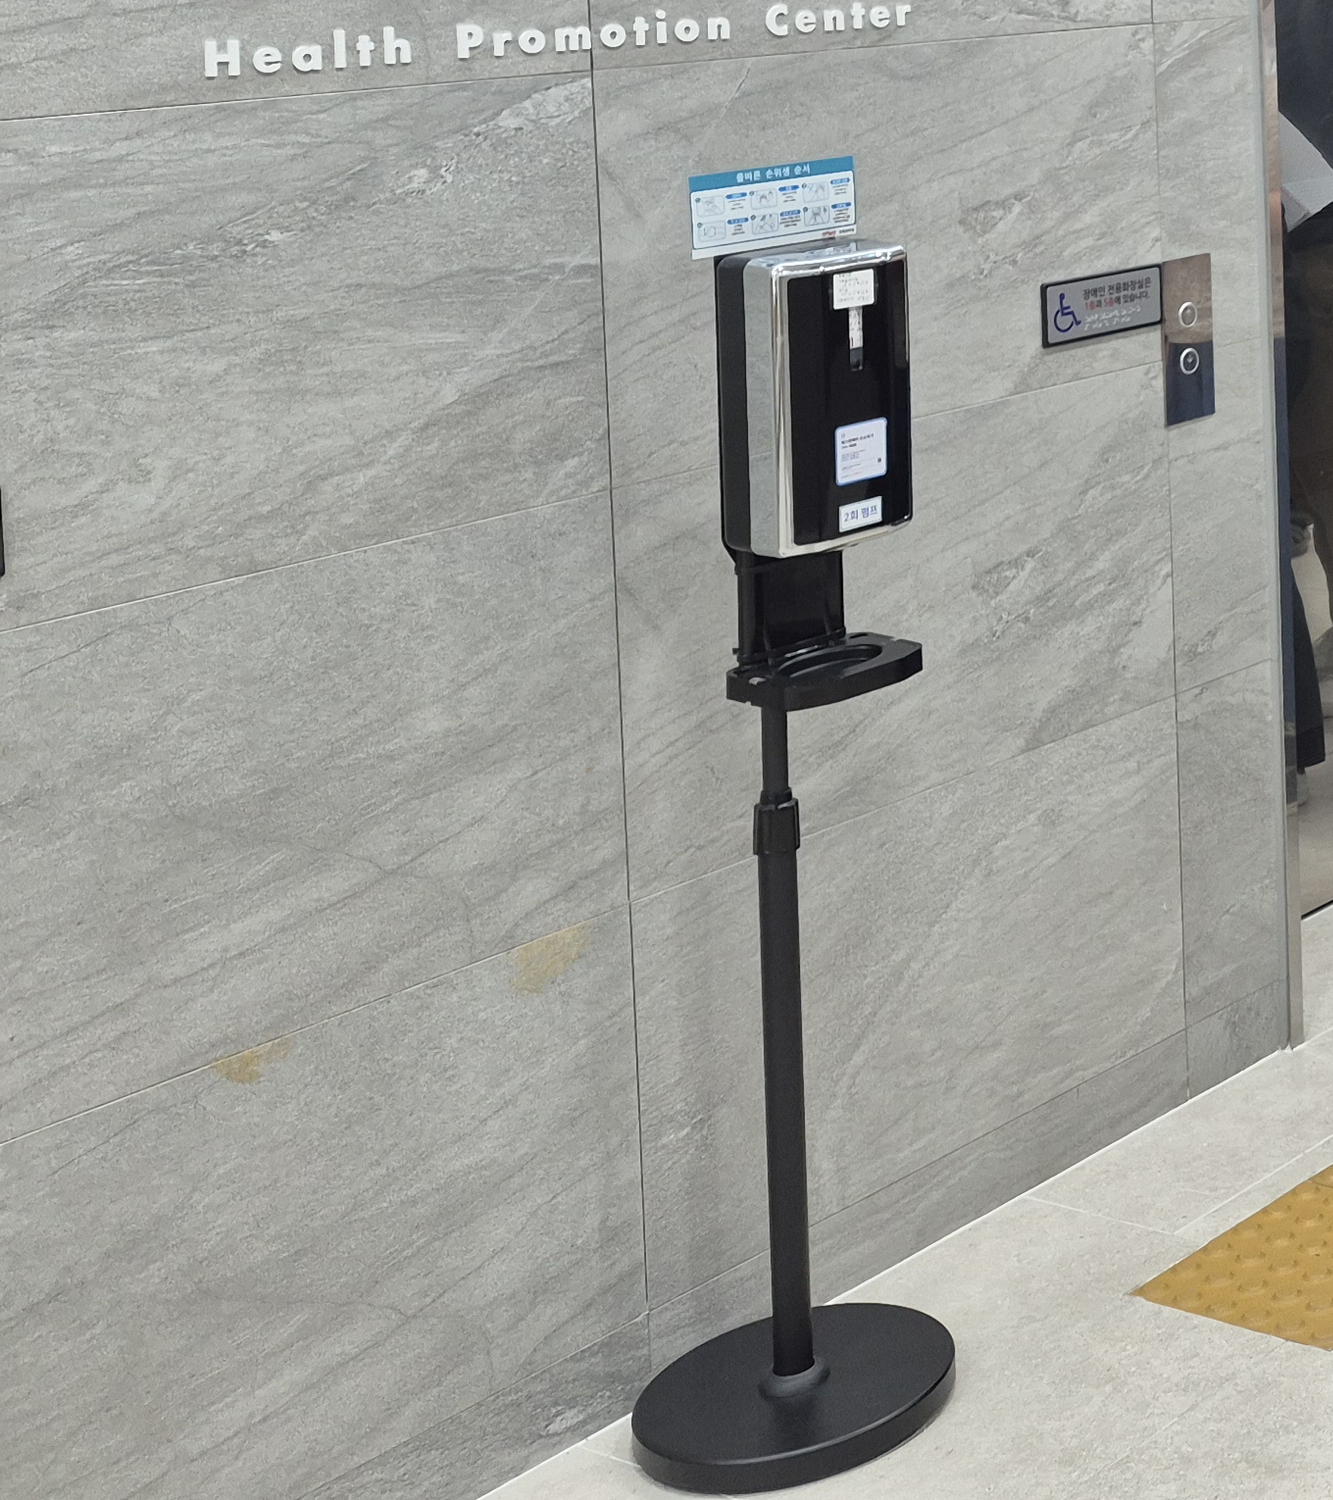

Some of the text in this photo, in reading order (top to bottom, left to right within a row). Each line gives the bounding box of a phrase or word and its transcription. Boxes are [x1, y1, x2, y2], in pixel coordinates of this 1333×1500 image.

[203, 0, 913, 78] Health Promotion Center
[1082, 285, 1106, 301] 장애인
